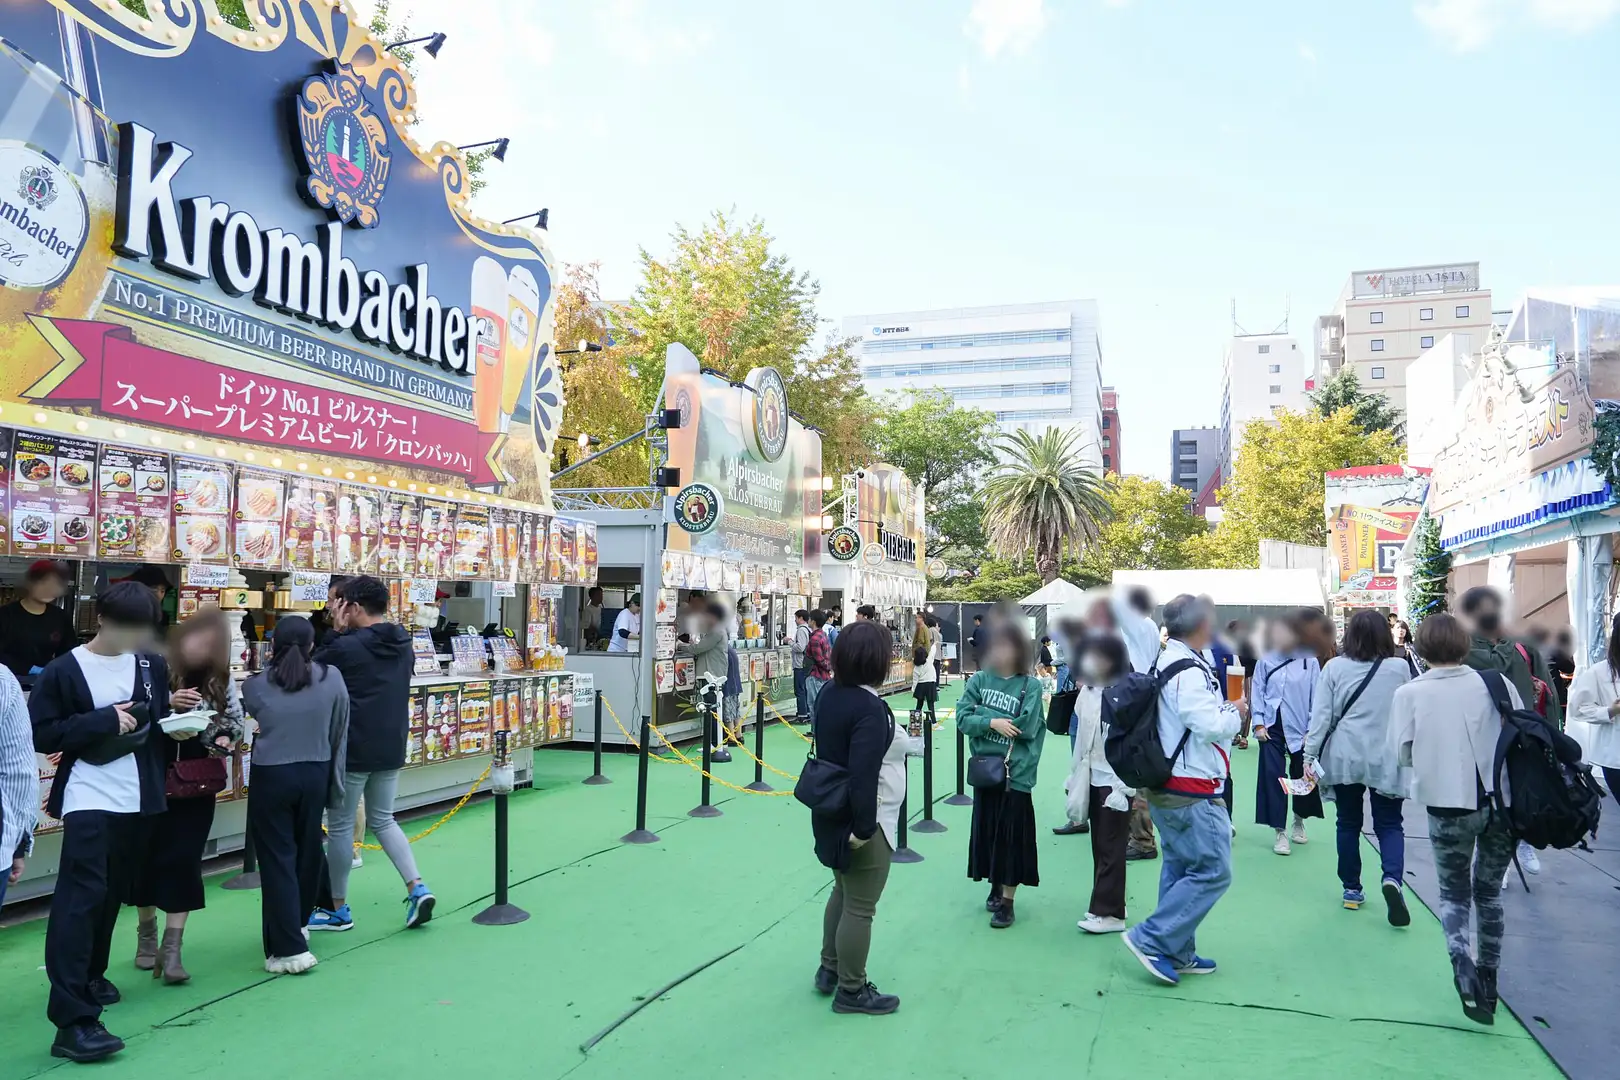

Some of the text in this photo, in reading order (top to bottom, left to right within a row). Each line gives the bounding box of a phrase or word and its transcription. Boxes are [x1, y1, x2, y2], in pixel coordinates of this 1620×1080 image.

[0, 198, 75, 260] mbacher
[122, 121, 486, 377] Krombacher
[1426, 271, 1467, 284] VISTA
[114, 279, 472, 411] No.1 PREMIUM BEER BRAND IN GERMANY
[219, 373, 417, 435] ドイツ No.1 ピルスナー！
[113, 382, 473, 472] スーパープレミアムビール「クロンバッハ」
[728, 456, 783, 492] Alpirsbacher
[675, 486, 715, 511] Alpirsbacher
[728, 485, 782, 513] KLOSTERBRÄU
[679, 511, 715, 530] KLOSTERBRÄU
[1339, 533, 1351, 571] PAULANER
[1359, 523, 1371, 559] PAULANER
[237, 593, 247, 605] 2
